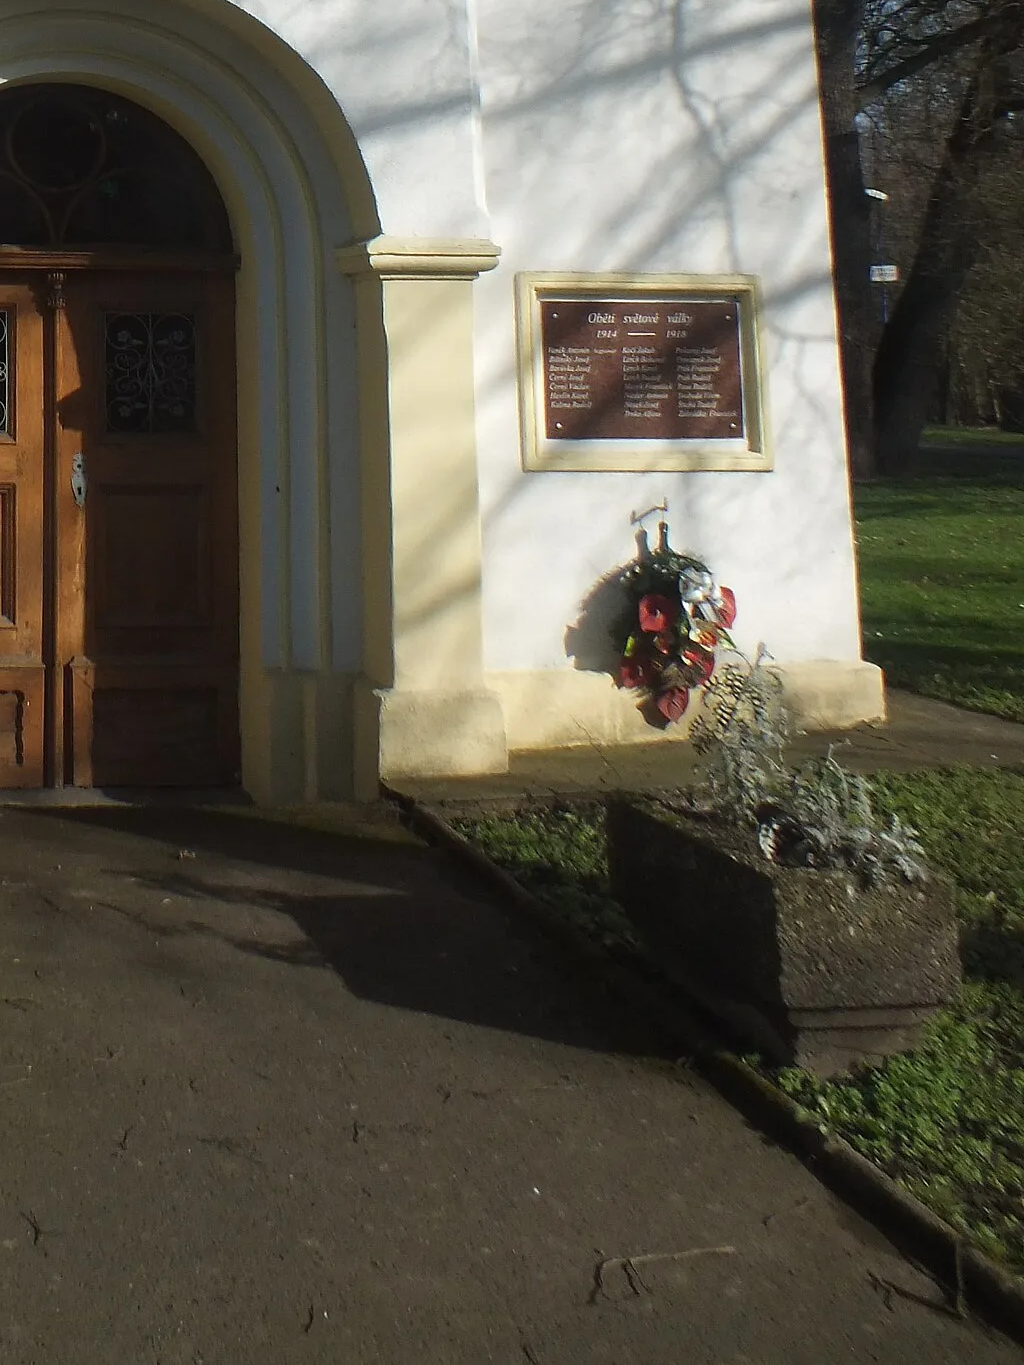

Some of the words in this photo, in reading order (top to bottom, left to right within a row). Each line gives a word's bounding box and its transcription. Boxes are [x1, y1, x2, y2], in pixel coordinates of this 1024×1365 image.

[588, 312, 615, 324] Oběti
[623, 312, 659, 324] světové
[666, 312, 693, 325] války
[596, 330, 617, 338] 1914
[666, 330, 687, 338] 1918
